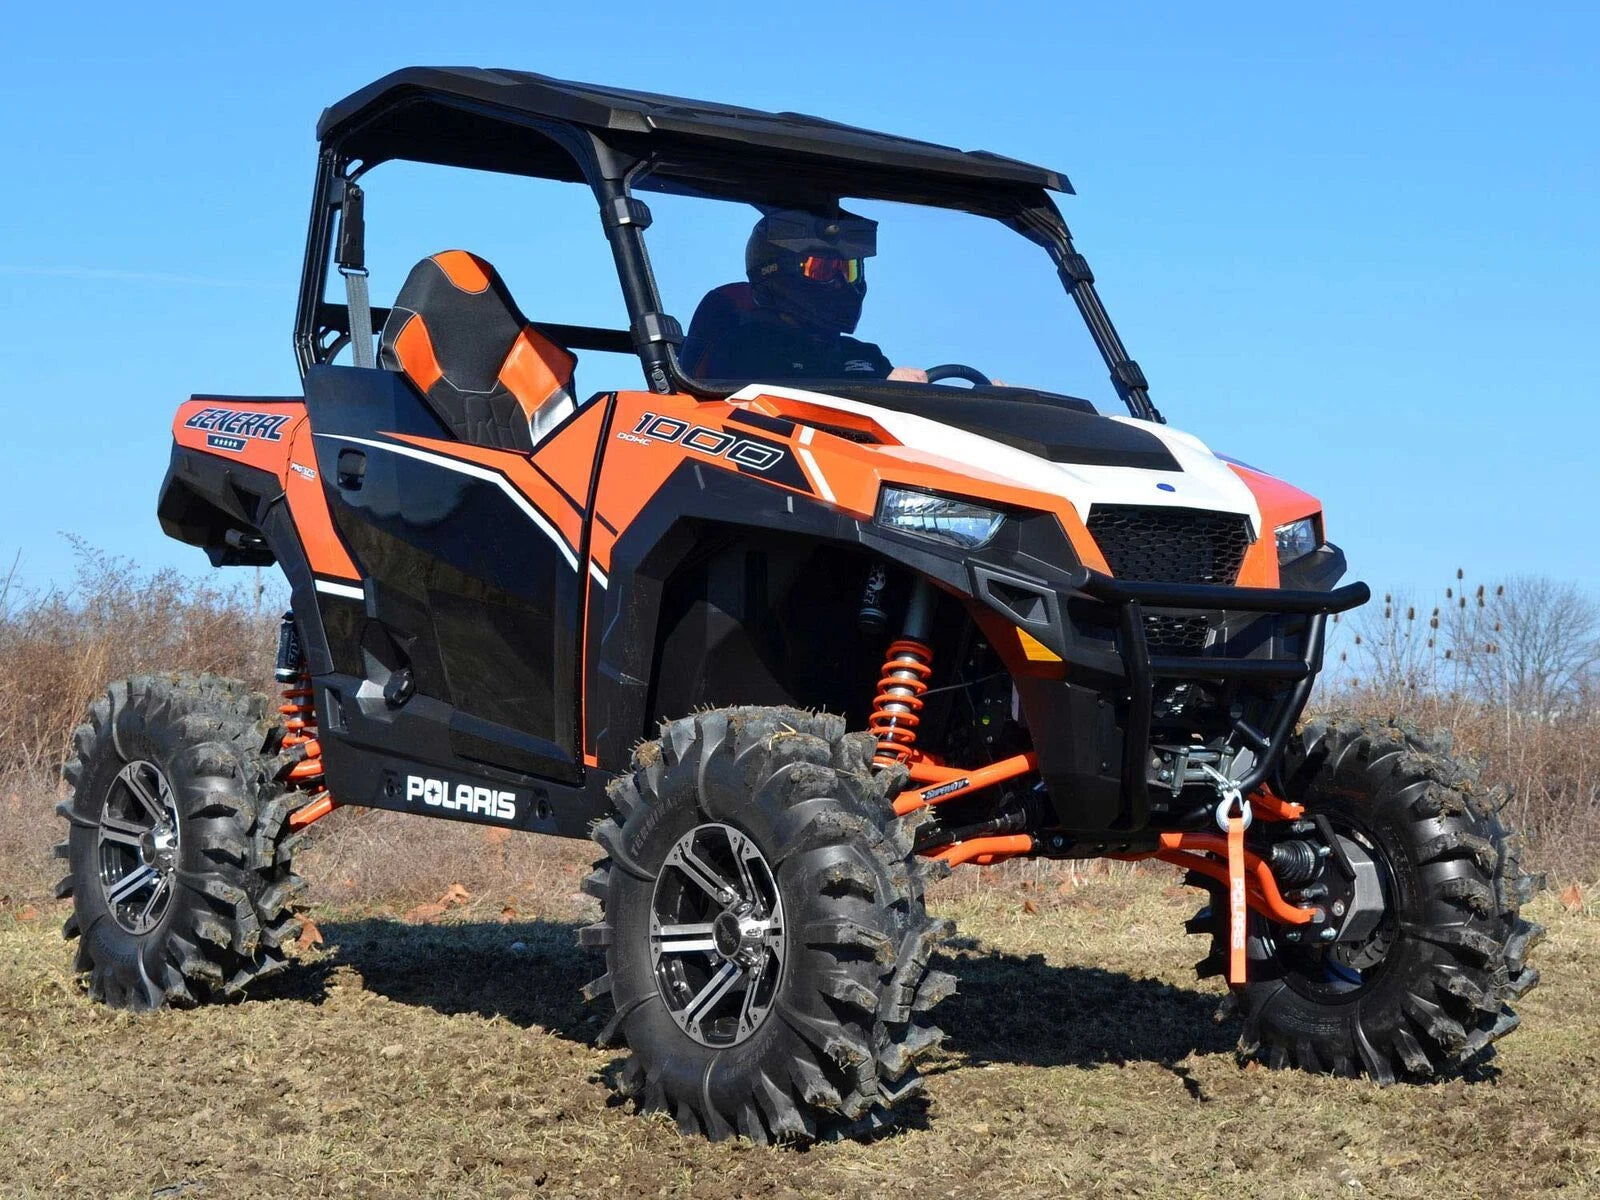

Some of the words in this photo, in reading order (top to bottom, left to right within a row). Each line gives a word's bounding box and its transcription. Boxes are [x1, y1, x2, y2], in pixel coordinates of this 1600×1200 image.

[184, 407, 293, 442] GENERAL
[616, 432, 652, 446] DOHC
[632, 411, 785, 471] 1000
[406, 775, 516, 820] POLARIS
